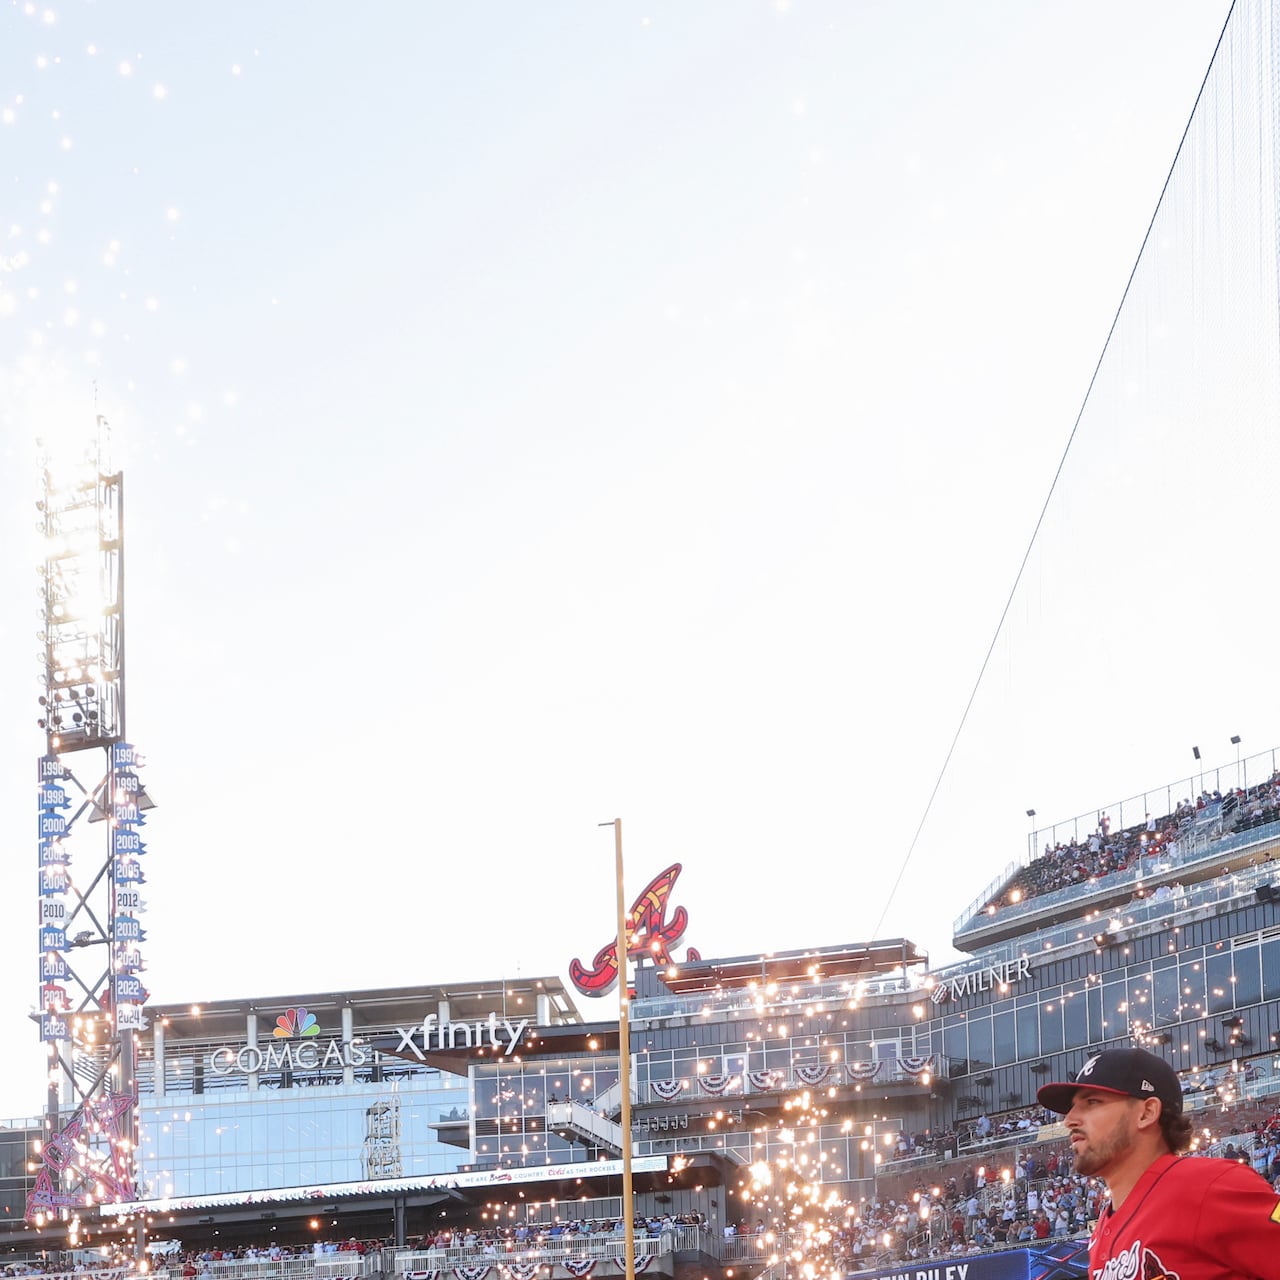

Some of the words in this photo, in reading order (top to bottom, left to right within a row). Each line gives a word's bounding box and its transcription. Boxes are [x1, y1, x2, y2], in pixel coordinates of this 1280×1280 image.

[116, 777, 138, 791] 1999
[42, 790, 65, 804] 1998
[42, 818, 65, 832] 2000
[116, 834, 139, 849] 2003
[116, 893, 139, 908] 2012
[42, 904, 65, 918] 2010
[116, 921, 139, 937] 2018
[43, 961, 65, 976] 2019
[117, 979, 140, 995] 2022
[951, 958, 1033, 1002] MILNER
[43, 1020, 66, 1036] 2023
[210, 1038, 381, 1075] COMCAST
[395, 1011, 529, 1060] xfinity
